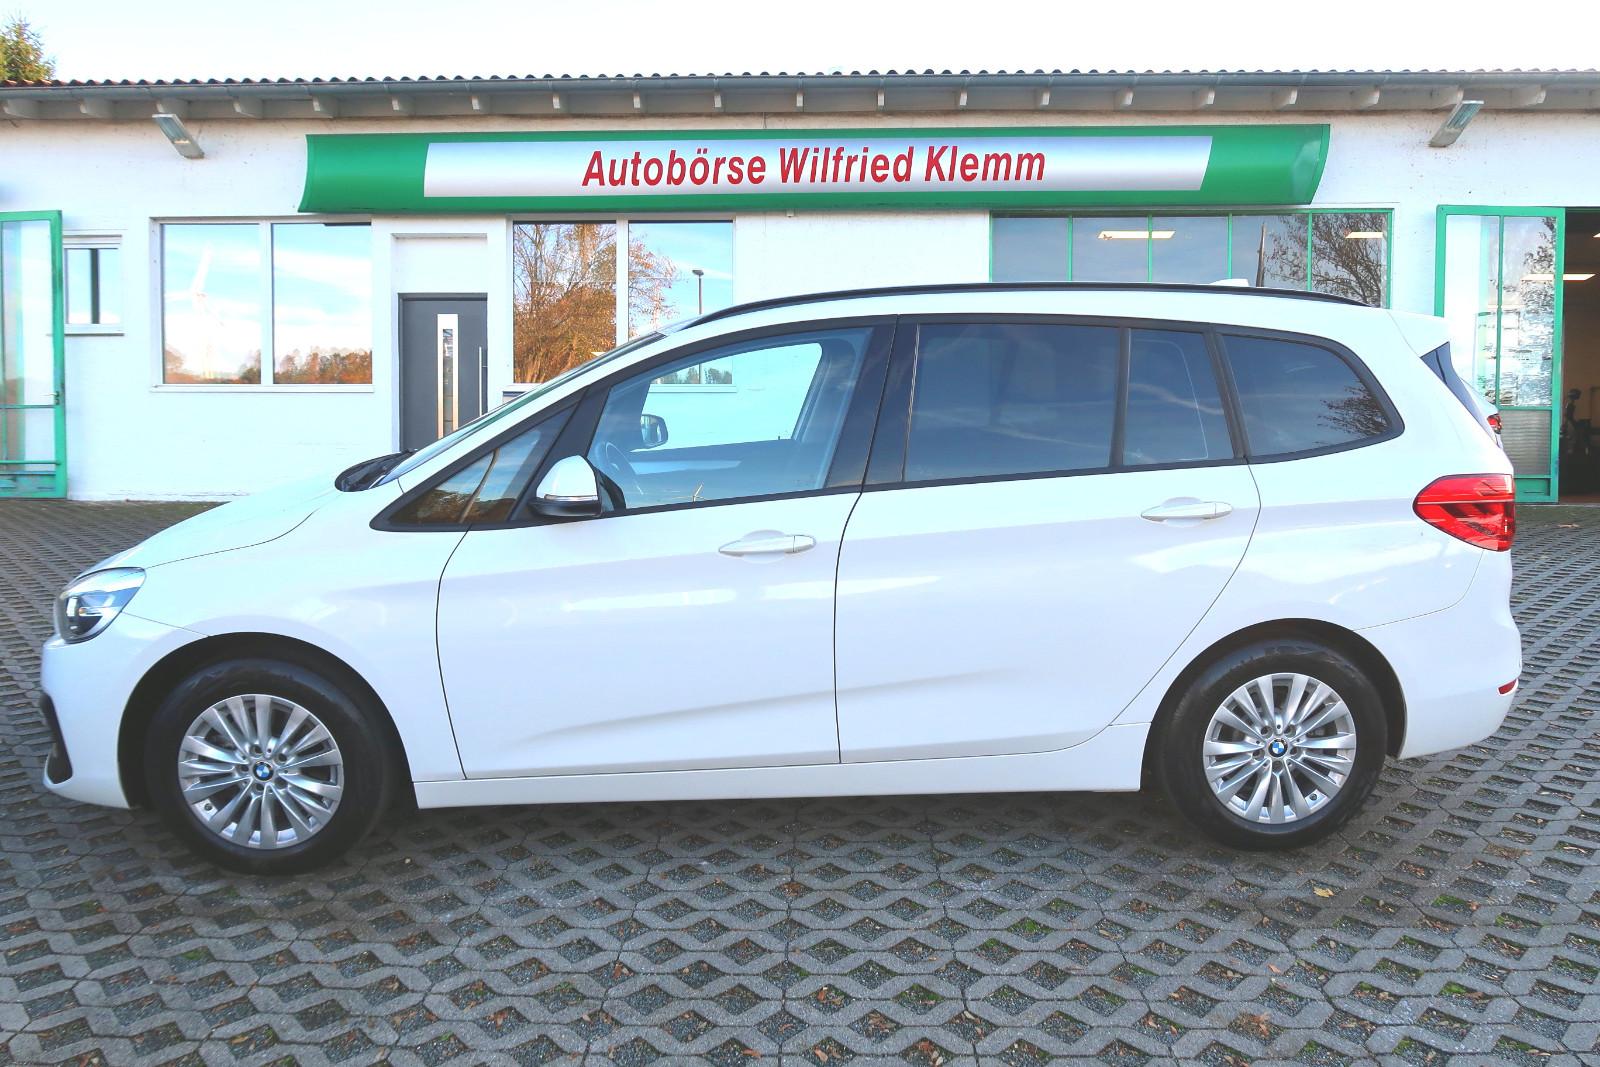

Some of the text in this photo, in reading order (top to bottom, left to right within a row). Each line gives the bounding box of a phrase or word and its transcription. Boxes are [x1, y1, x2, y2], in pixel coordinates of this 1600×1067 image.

[582, 145, 1046, 187] Autobörse Wilfried Klemm
